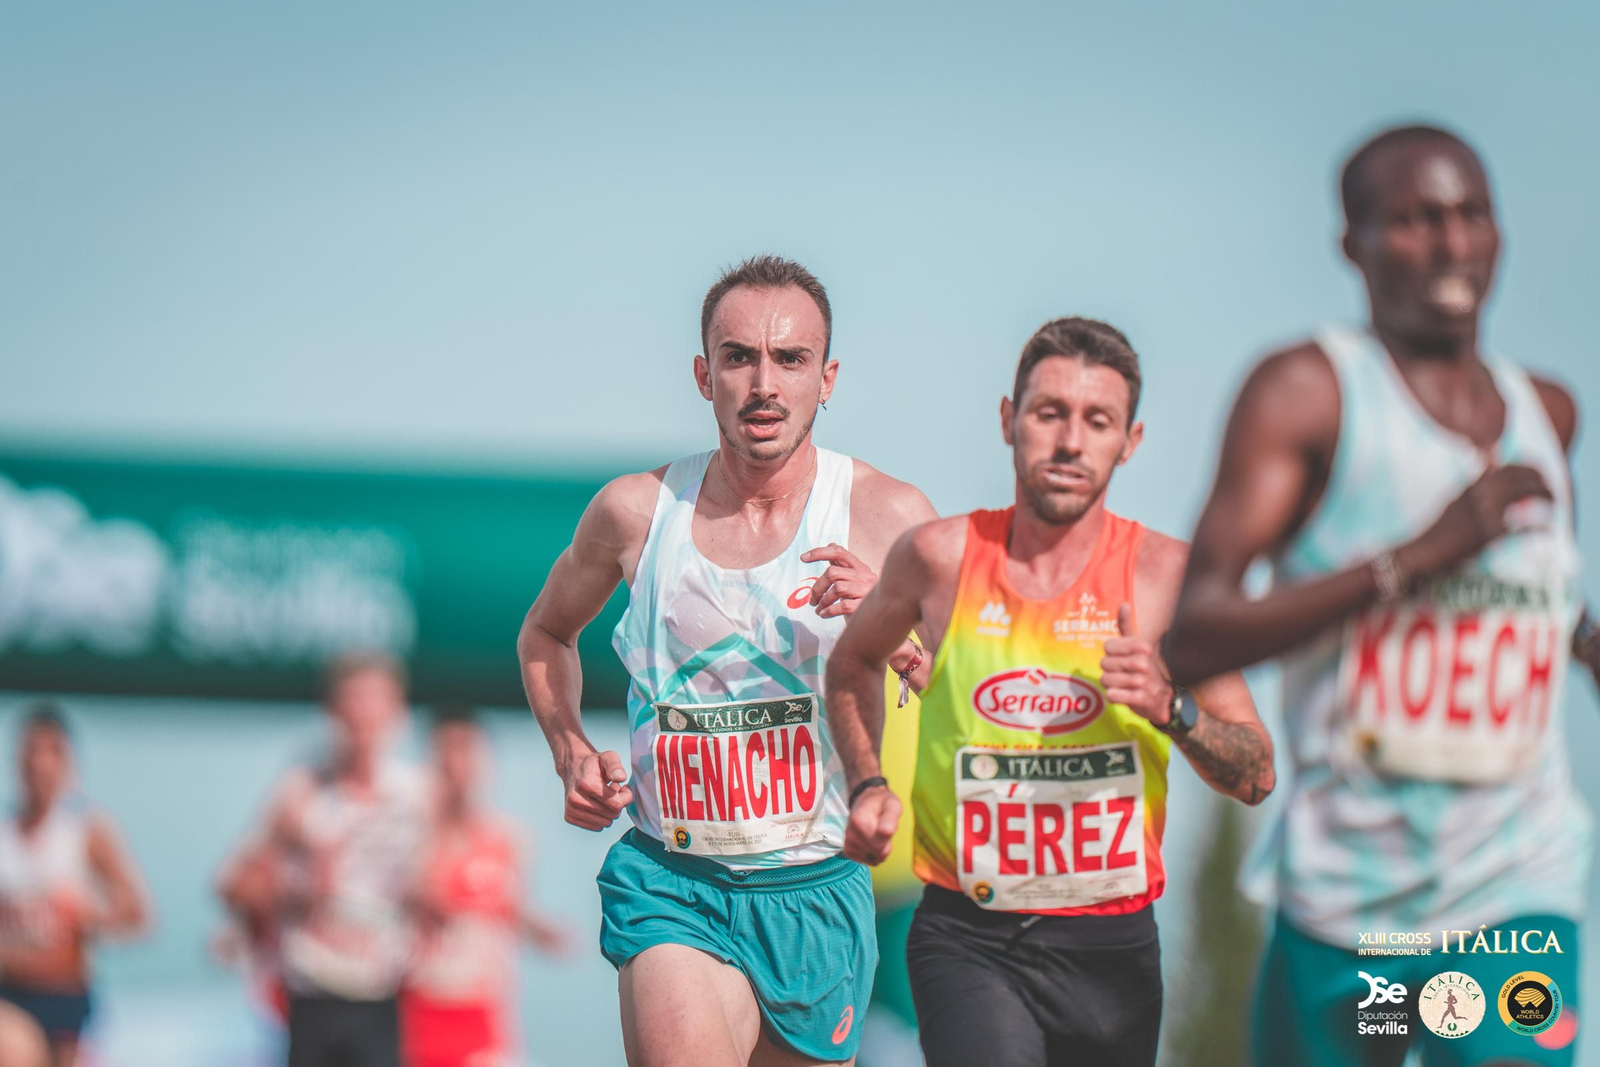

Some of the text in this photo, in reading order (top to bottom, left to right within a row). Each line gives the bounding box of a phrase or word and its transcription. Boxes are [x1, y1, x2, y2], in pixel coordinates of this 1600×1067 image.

[1346, 607, 1557, 732] KOECH
[693, 708, 773, 728] ITÁLICA
[987, 686, 1092, 715] Serrano
[656, 725, 817, 821] MENACHO
[1007, 756, 1095, 777] ITÁLICA
[963, 783, 1137, 876] PÉREZ
